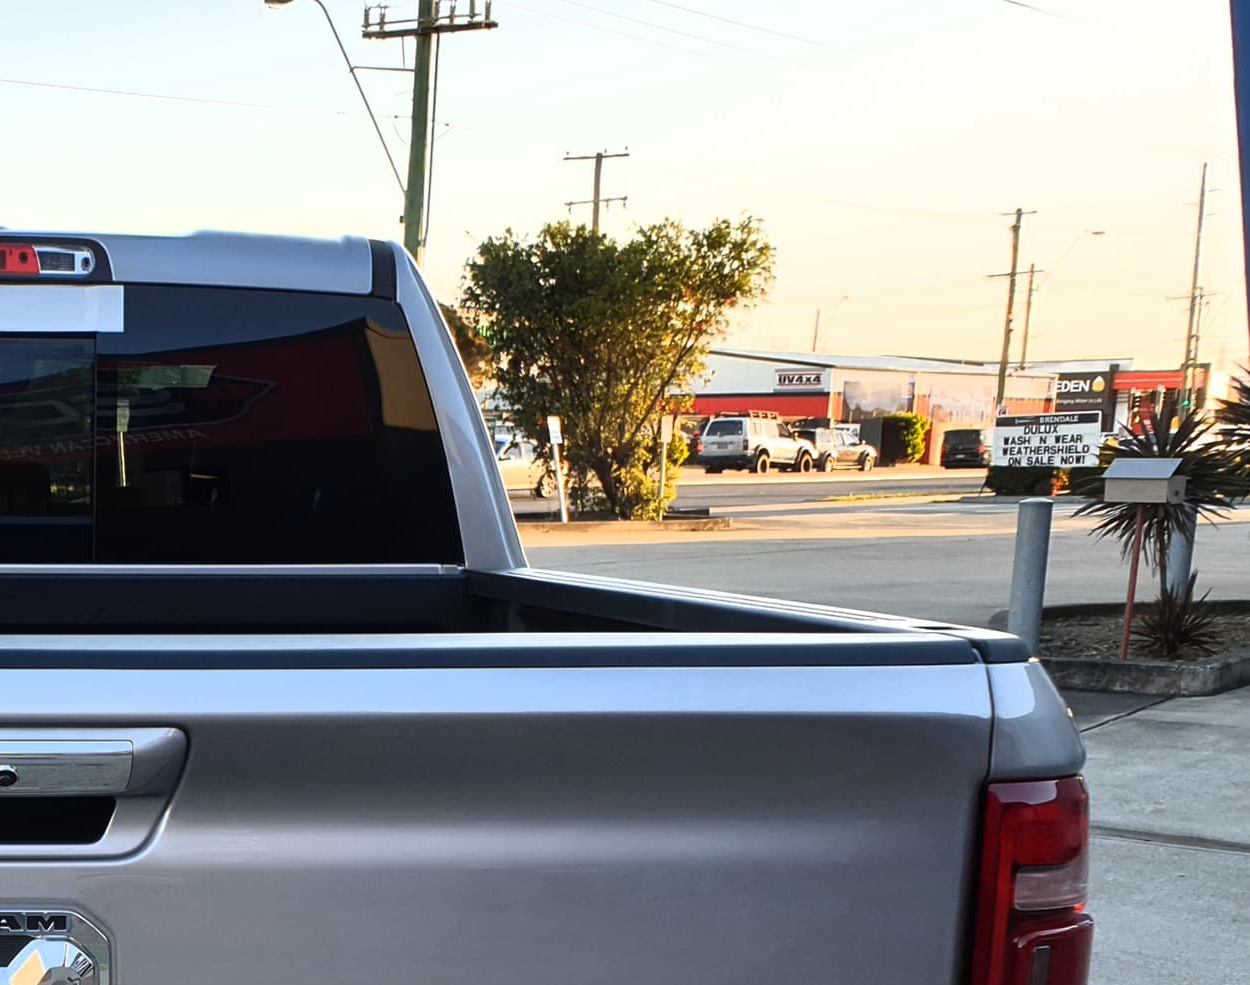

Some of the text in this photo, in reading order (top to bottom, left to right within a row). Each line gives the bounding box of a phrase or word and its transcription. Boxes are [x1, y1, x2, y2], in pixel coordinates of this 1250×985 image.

[1039, 415, 1079, 423] BRENDALE
[1024, 425, 1059, 435] DULUX
[1003, 434, 1083, 446] WASH N WEAR
[1002, 445, 1090, 456] WEATHERSHIELD
[1008, 455, 1086, 466] ON SALE NOW!
